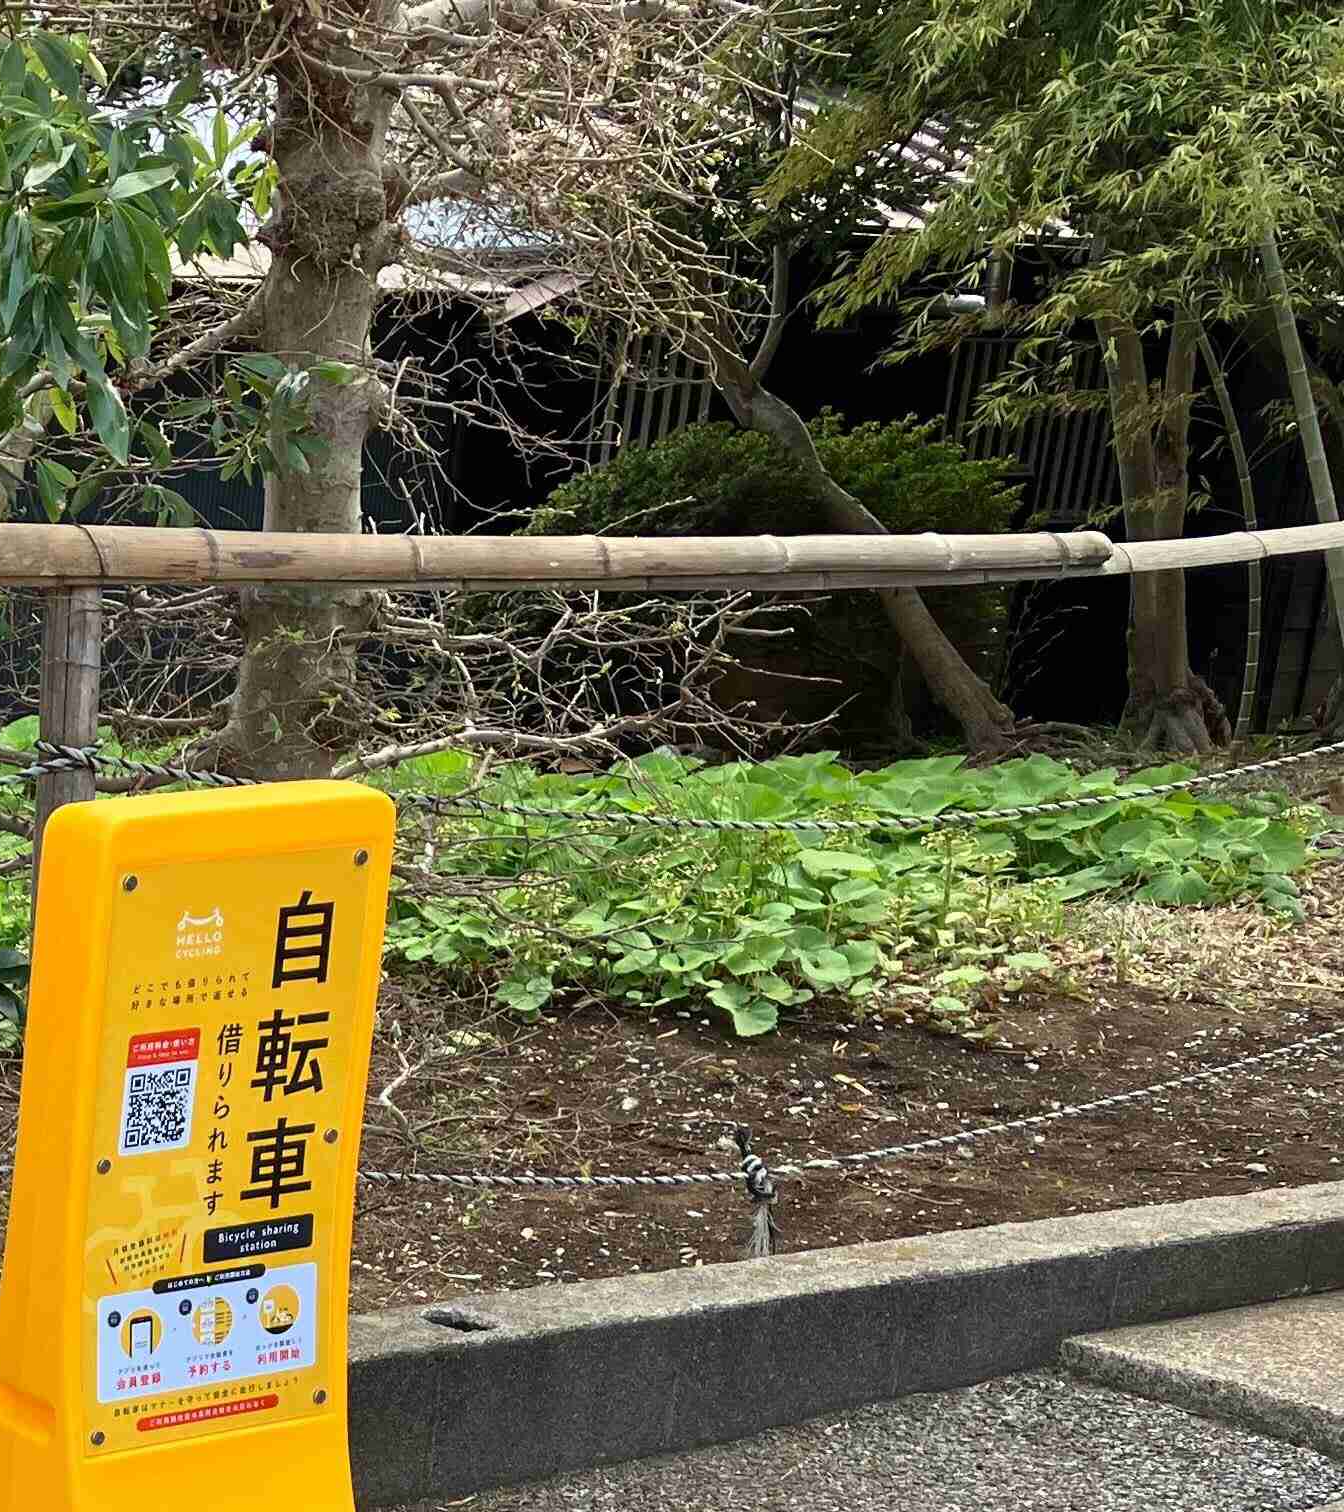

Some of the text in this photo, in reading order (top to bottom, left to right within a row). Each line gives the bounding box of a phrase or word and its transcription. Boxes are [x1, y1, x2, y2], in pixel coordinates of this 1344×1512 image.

[176, 930, 223, 946] HELLO
[239, 889, 336, 1209] 自転車
[203, 1023, 243, 1215] 借りられます
[218, 1222, 299, 1244] Bicycle sharing
[240, 1239, 277, 1254] station
[256, 1348, 301, 1365] 利用開始
[186, 1360, 232, 1379] 予約する
[116, 1374, 161, 1391] 会員登録
